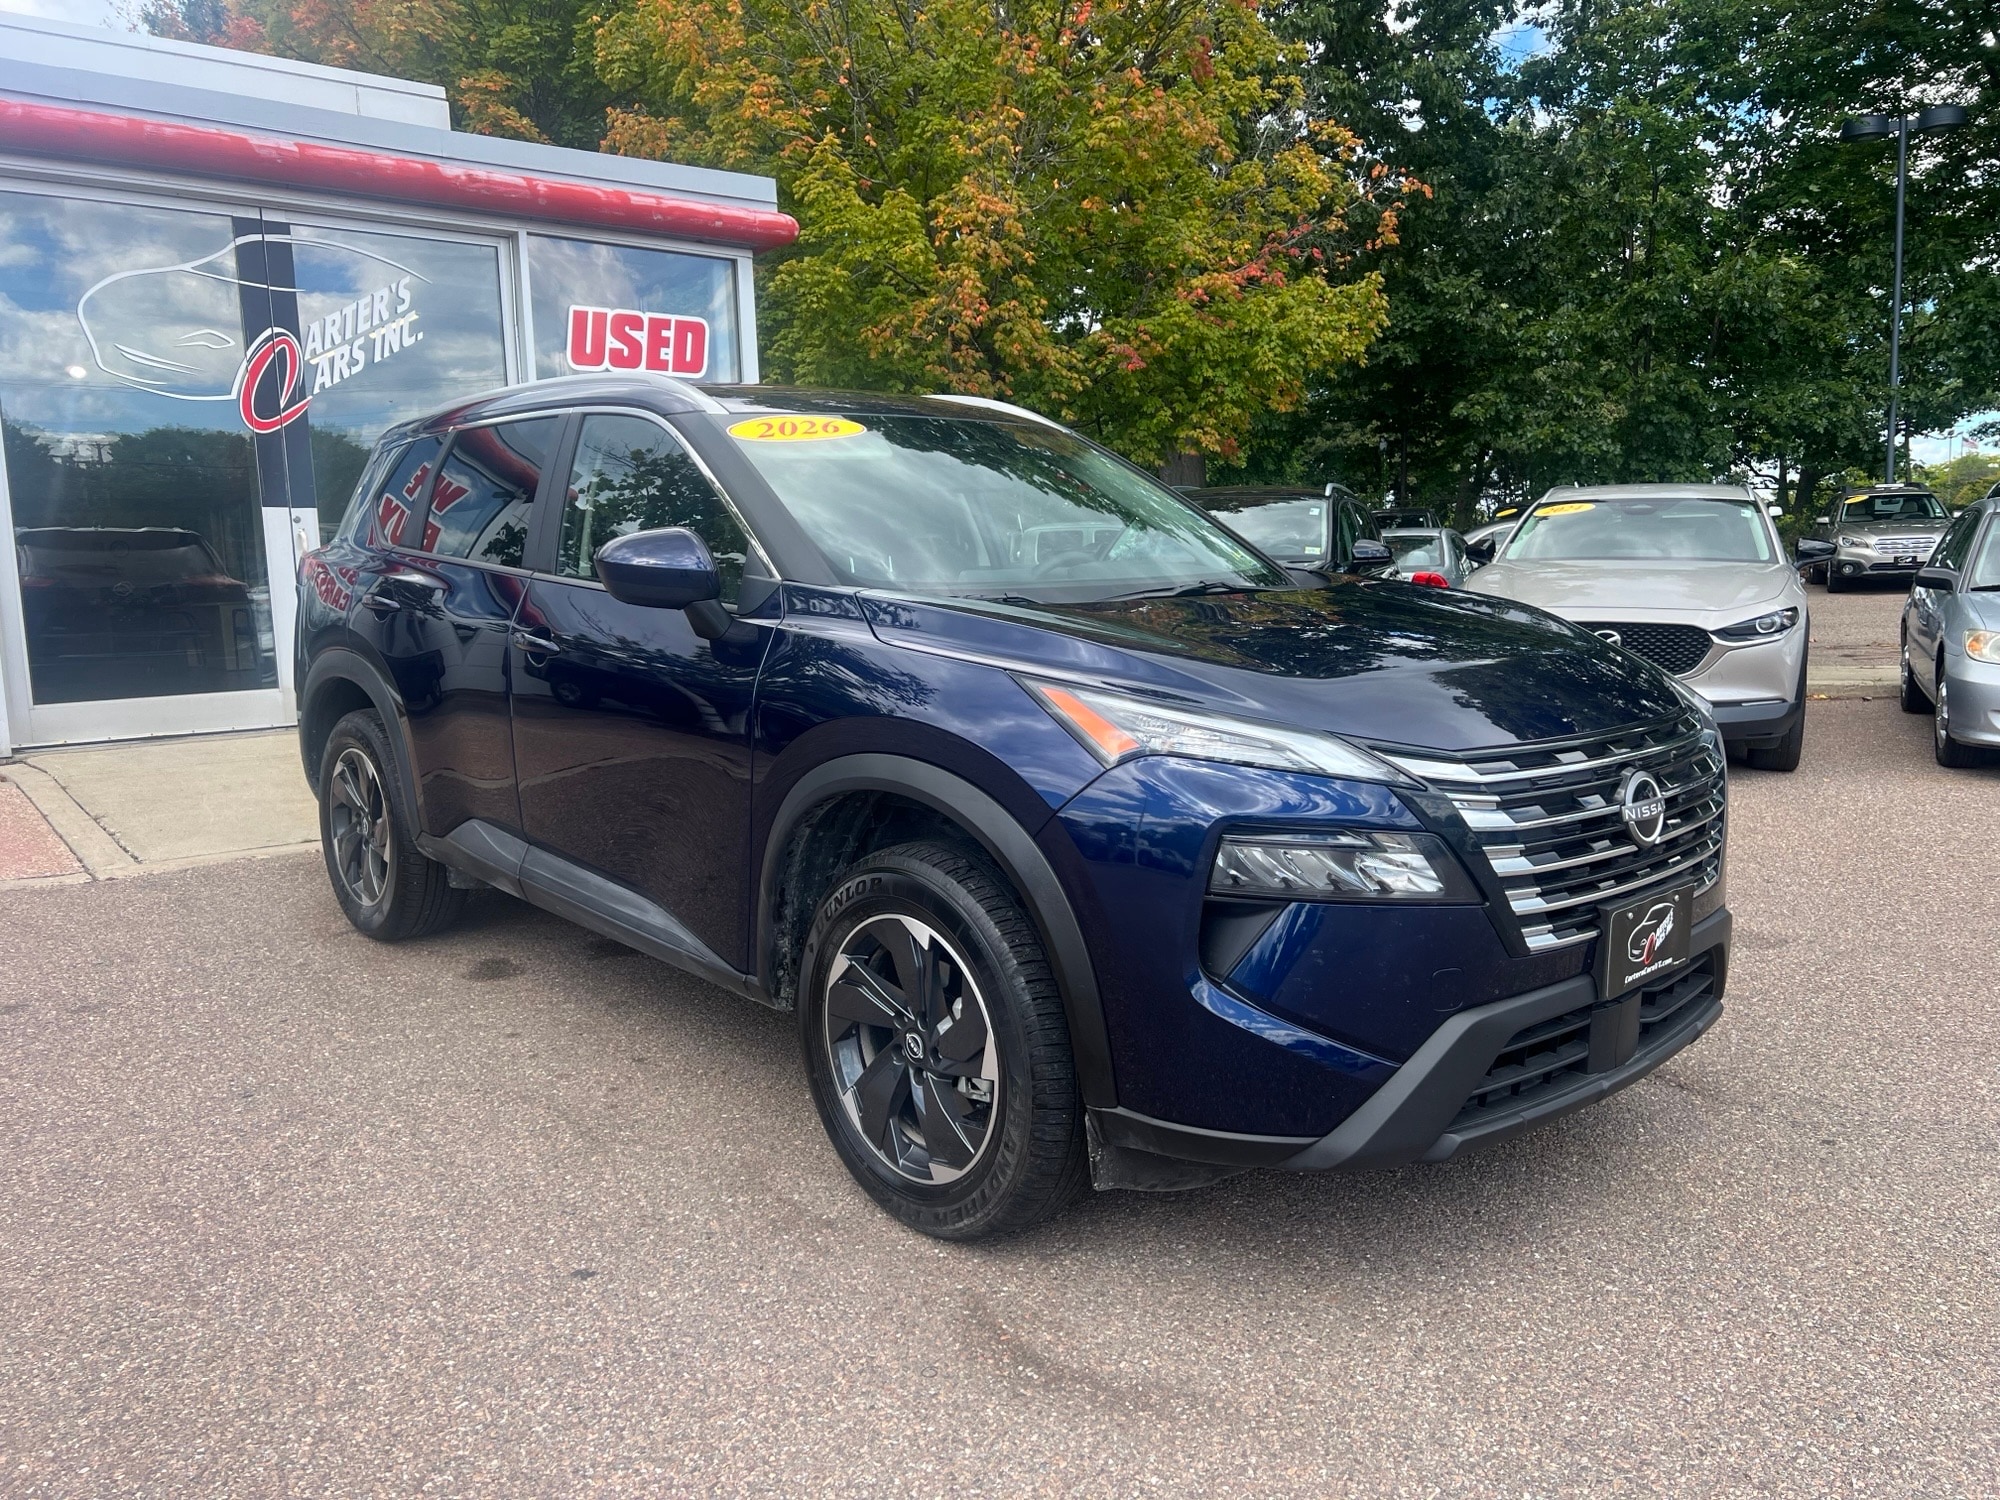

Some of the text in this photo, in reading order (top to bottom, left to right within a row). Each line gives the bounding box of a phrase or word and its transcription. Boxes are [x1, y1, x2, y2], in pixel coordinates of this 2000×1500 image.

[370, 311, 424, 364] INC.
[569, 308, 707, 376] USED
[756, 419, 840, 438] 2026
[815, 876, 883, 936] DUNLOP
